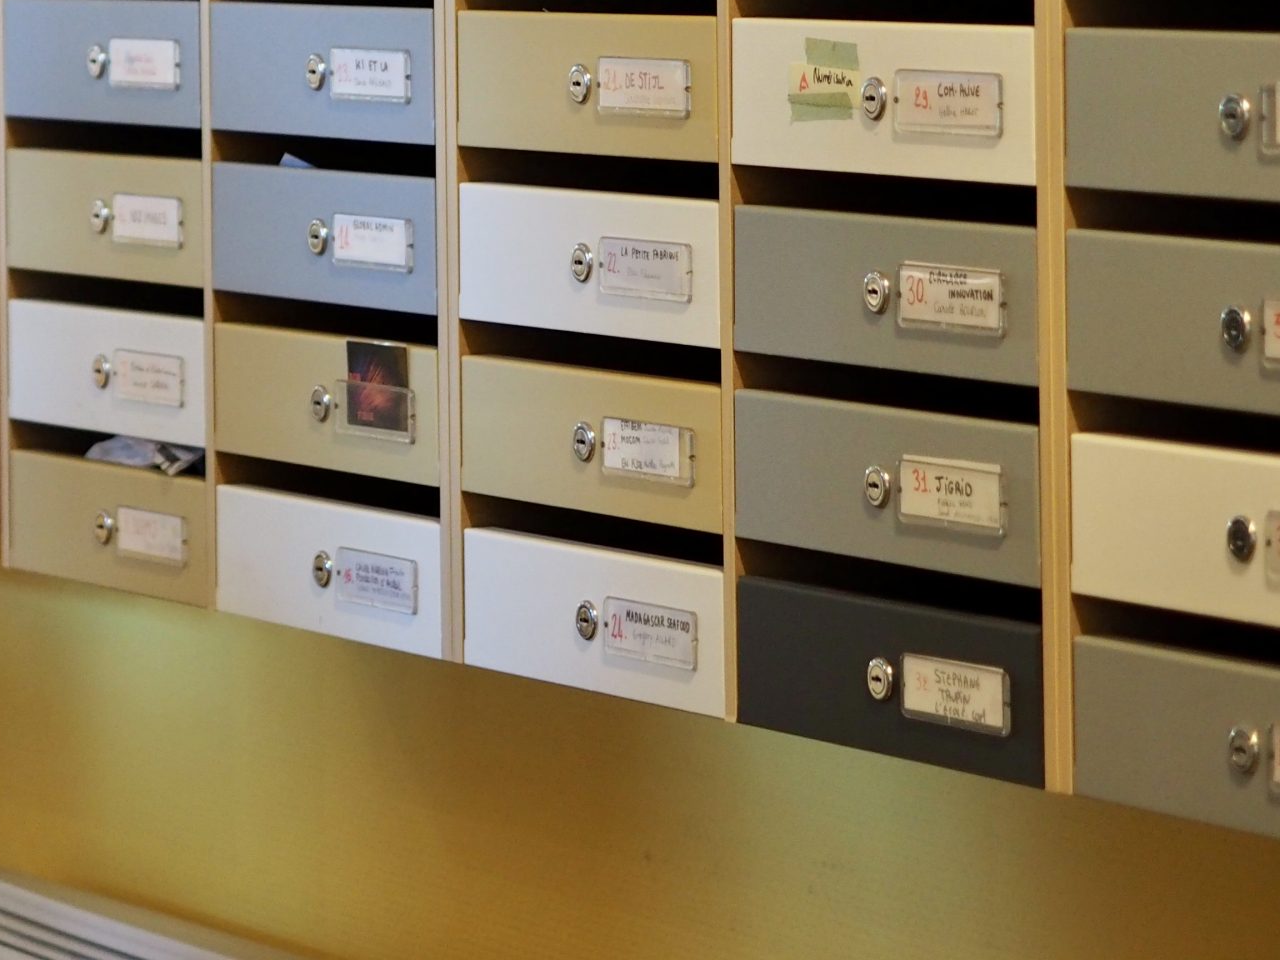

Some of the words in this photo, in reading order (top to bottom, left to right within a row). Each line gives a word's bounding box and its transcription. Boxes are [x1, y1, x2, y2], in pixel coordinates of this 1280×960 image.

[620, 246, 629, 257] LA
[631, 247, 650, 261] PETITE
[906, 274, 928, 305] 30.
[948, 288, 994, 302] INNOVATION
[625, 609, 665, 628] MADAGASCAR
